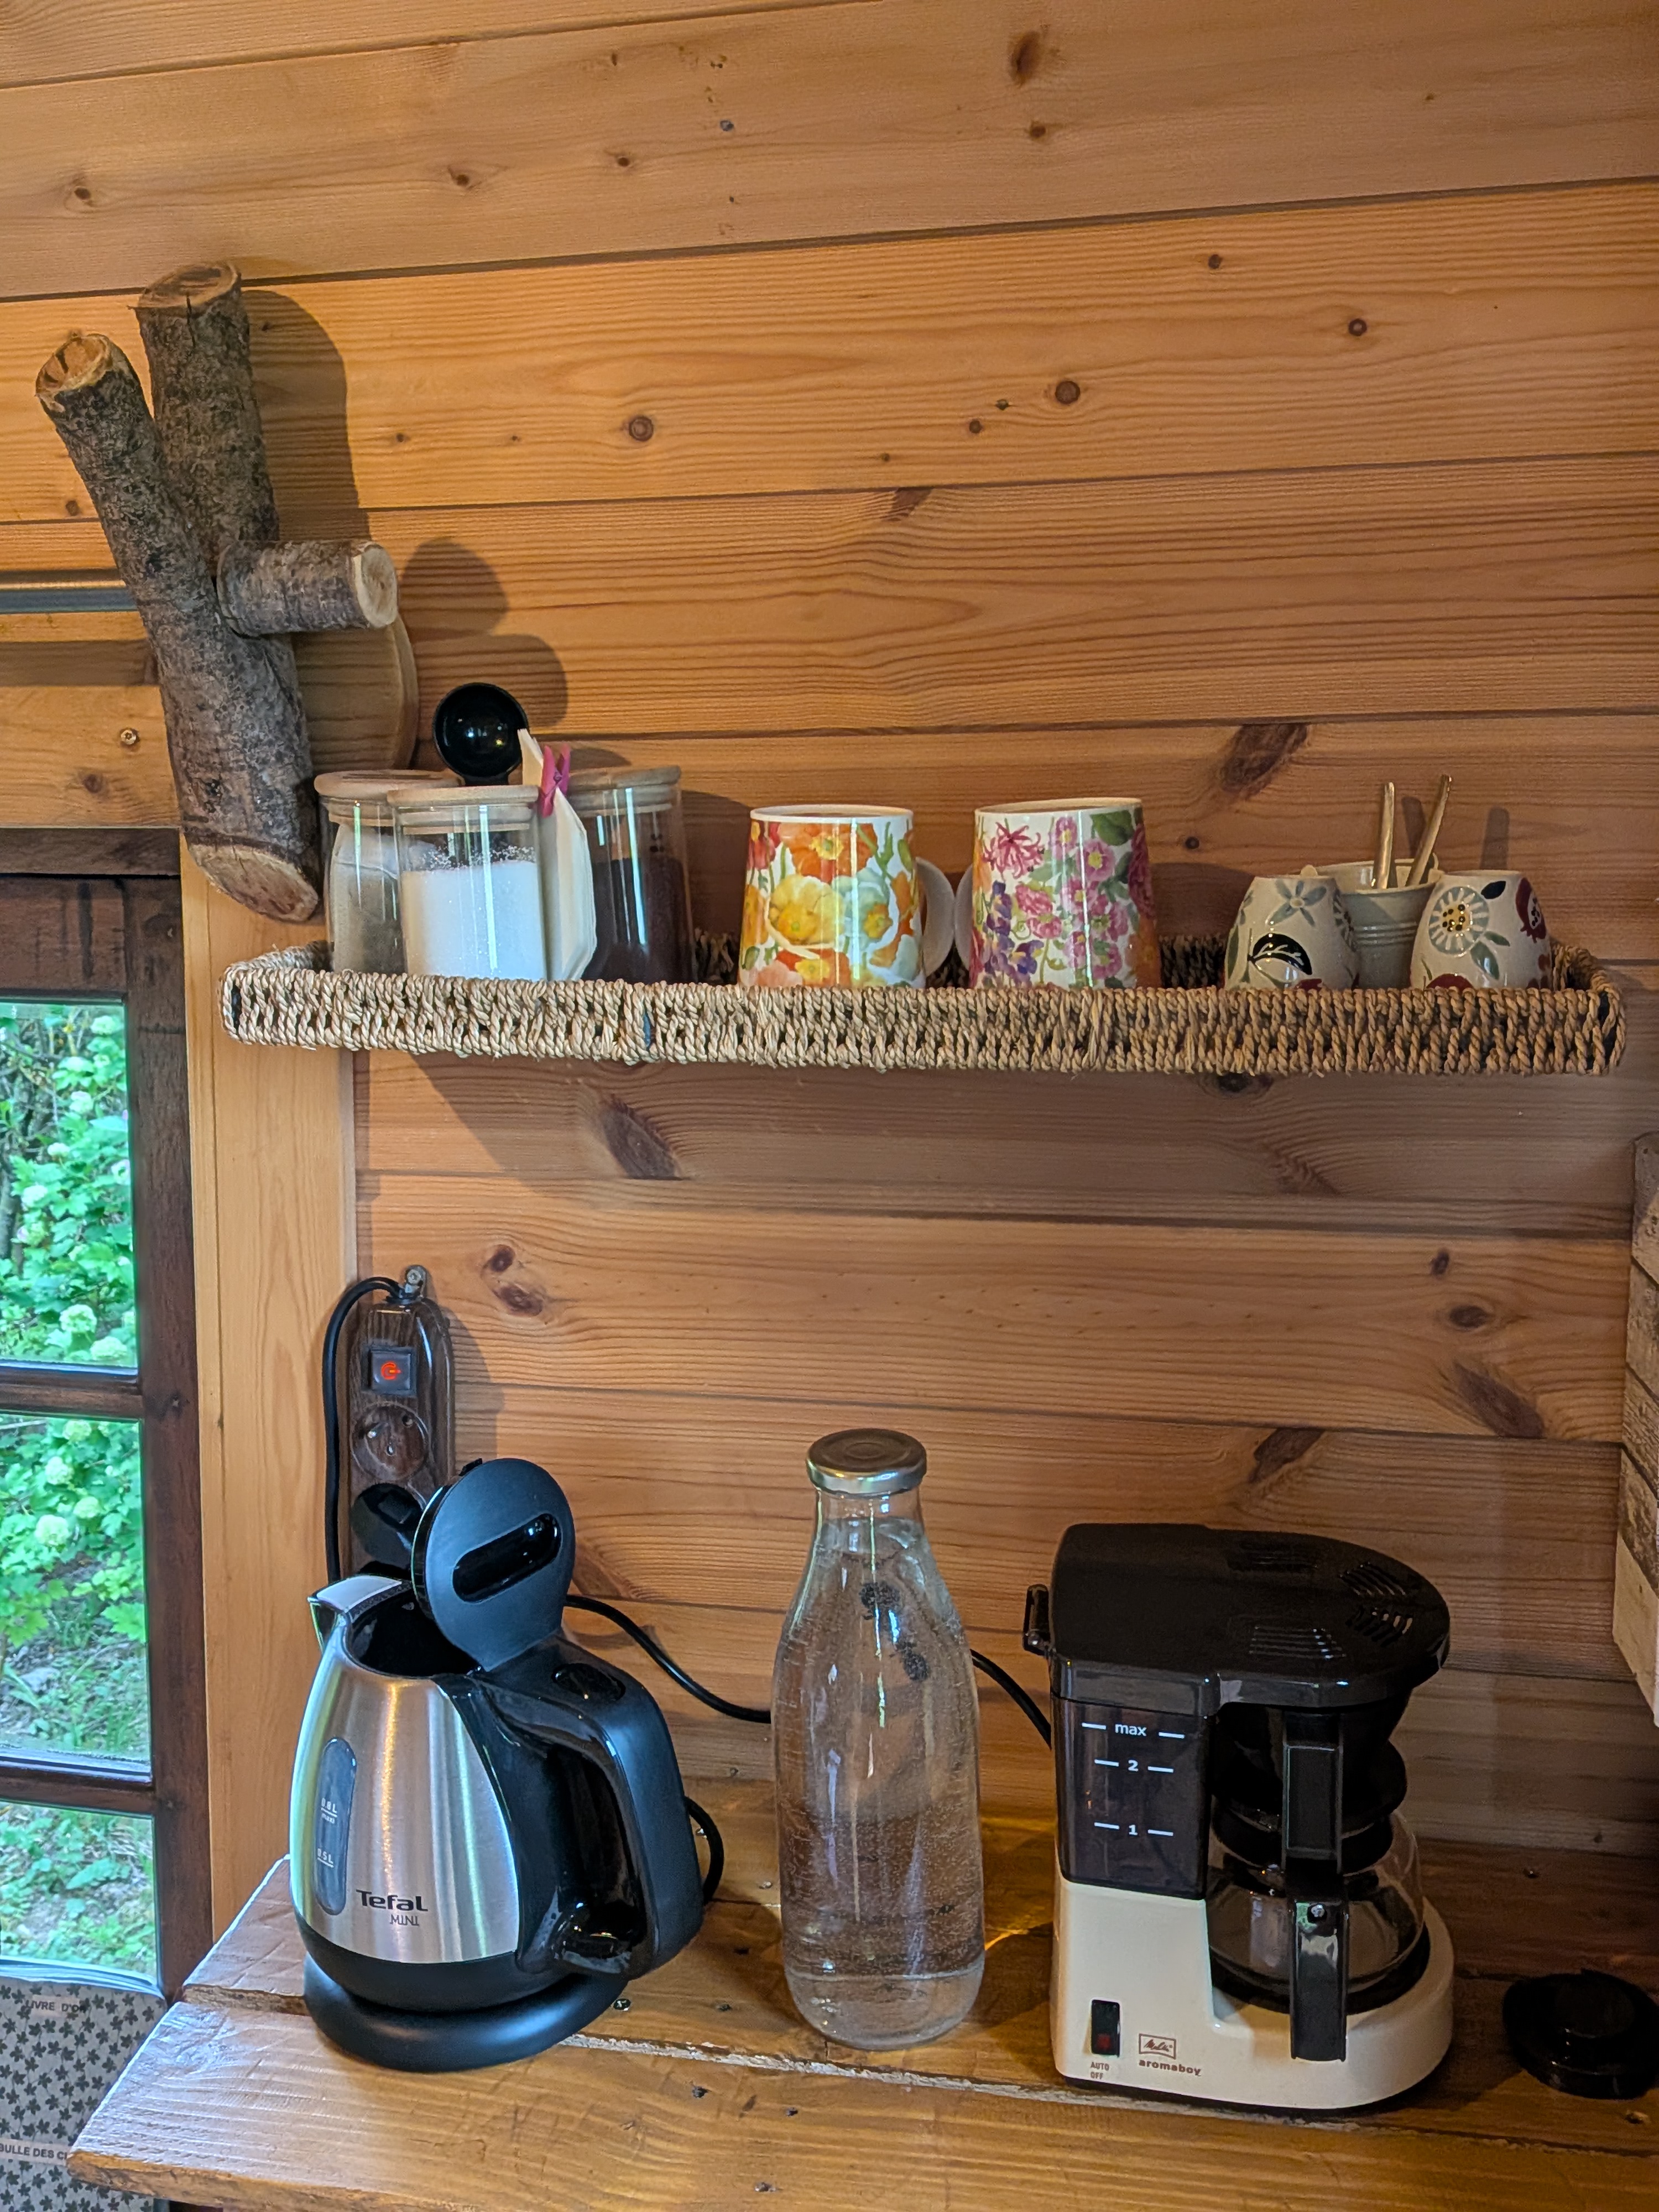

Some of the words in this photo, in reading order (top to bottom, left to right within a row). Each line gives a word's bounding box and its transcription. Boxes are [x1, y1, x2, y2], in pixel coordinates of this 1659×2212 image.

[1115, 1724, 1147, 1736] max
[1128, 1760, 1139, 1772] 2
[1129, 1824, 1138, 1836] 1
[356, 1889, 428, 1912] Tefal
[389, 1914, 420, 1926] MINI
[25, 2000, 55, 2011] LIVRE
[1091, 2062, 1109, 2071] AUTO
[1139, 2059, 1201, 2077] aromaboy
[1091, 2071, 1103, 2080] OFF
[33, 2148, 54, 2158] DES
